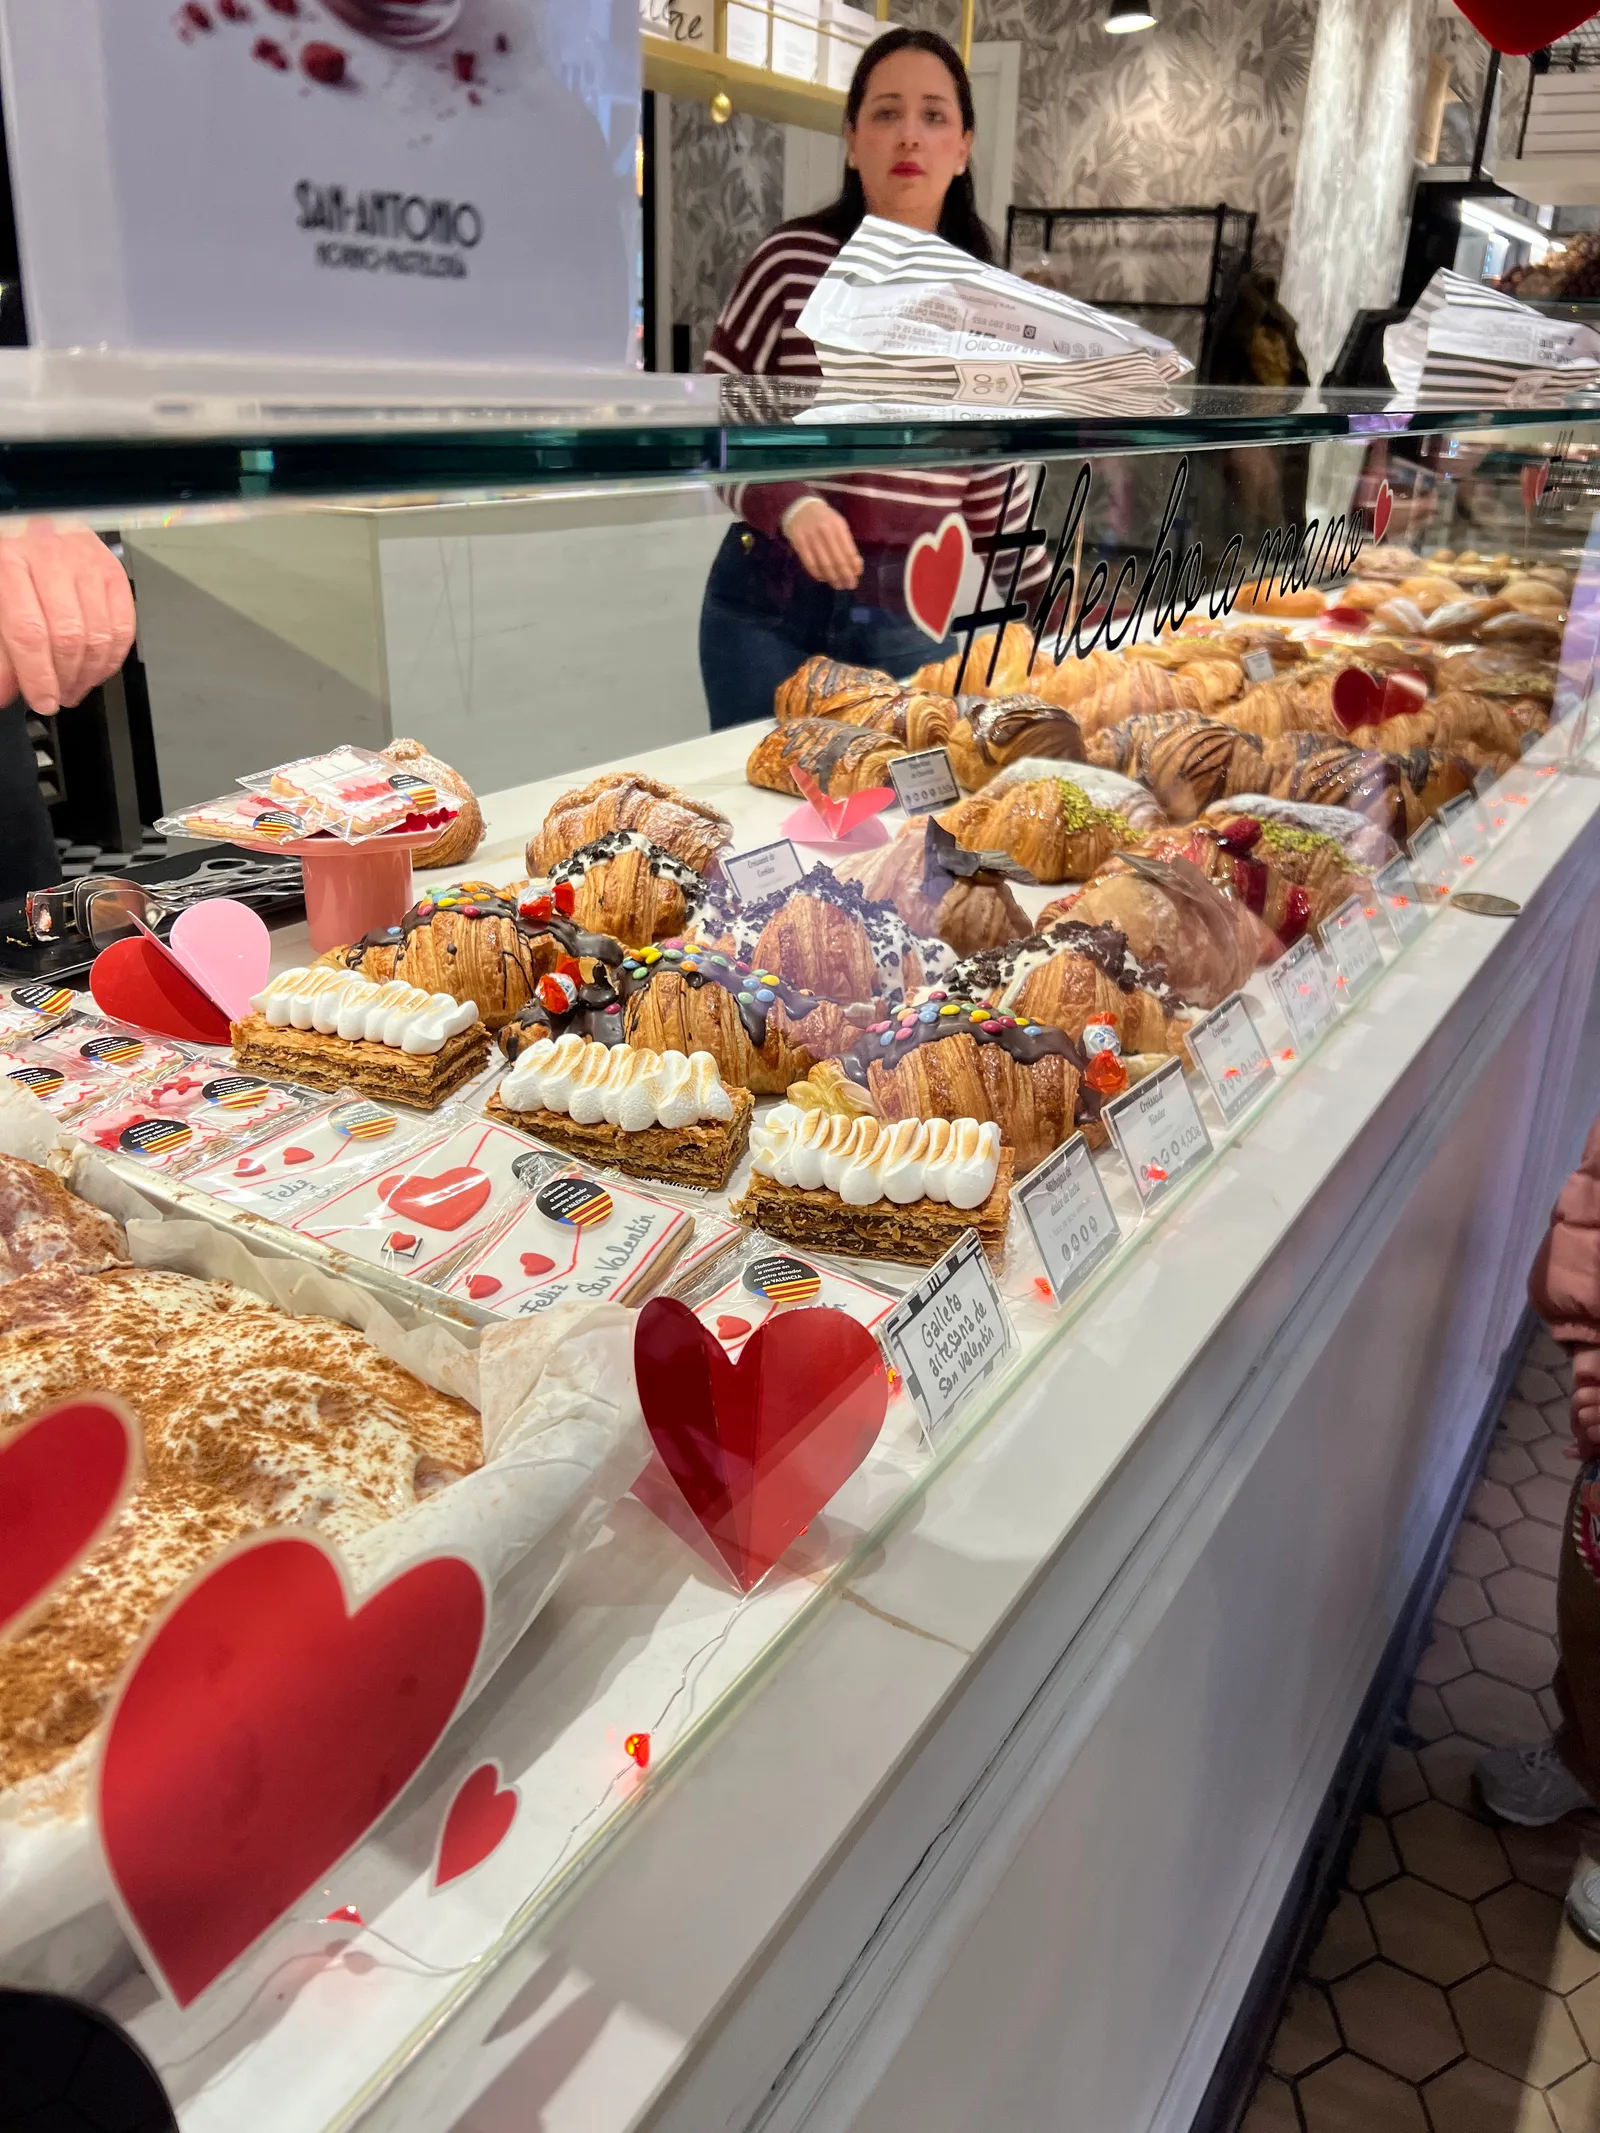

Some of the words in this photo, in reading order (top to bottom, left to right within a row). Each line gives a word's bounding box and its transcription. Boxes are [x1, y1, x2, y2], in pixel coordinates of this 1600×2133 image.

[594, 1214, 656, 1272] Valentín
[753, 1273, 777, 1282] nuestro
[777, 1268, 802, 1276] obrador
[754, 1259, 785, 1271] Elaborado
[763, 1266, 781, 1274] mano
[576, 1275, 618, 1297] San
[770, 1274, 803, 1284] VALENCIA
[518, 1284, 569, 1314] Feliz
[921, 1293, 963, 1348] Galleta
[928, 1314, 975, 1378] artesana
[973, 1298, 988, 1324] de
